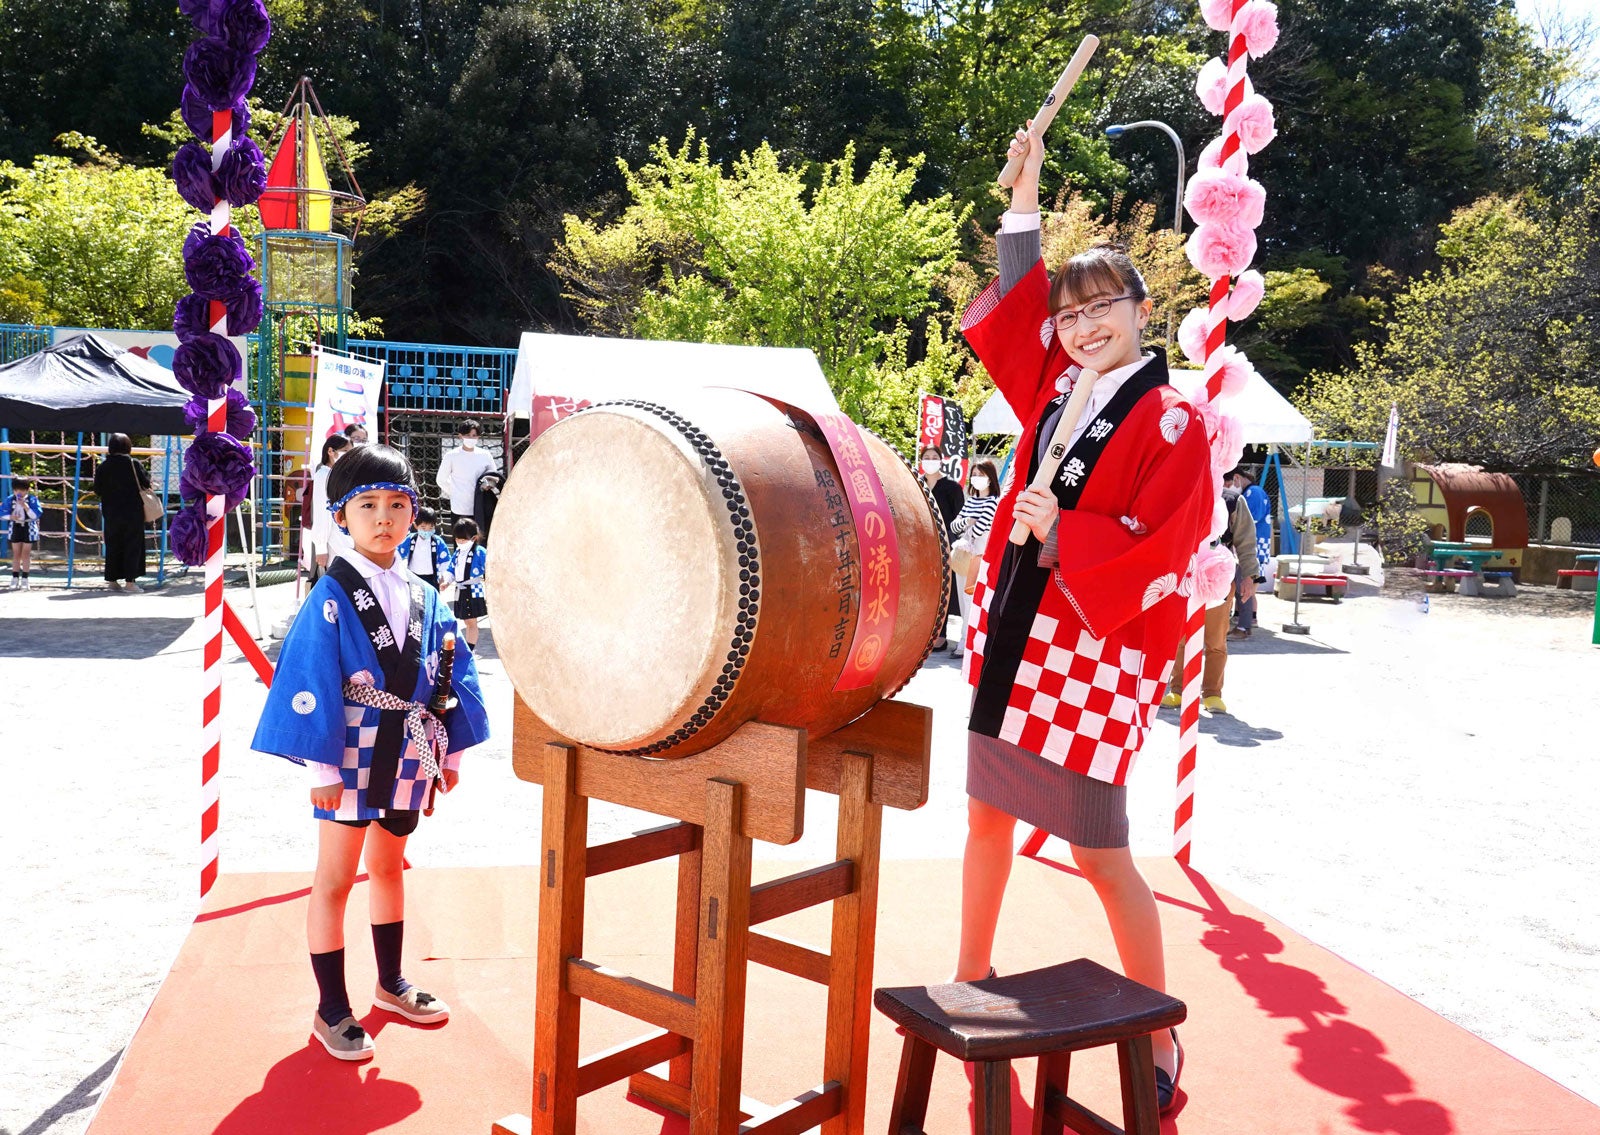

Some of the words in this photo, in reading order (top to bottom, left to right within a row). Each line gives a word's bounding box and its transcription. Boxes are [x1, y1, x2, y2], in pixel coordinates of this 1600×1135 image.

[1060, 418, 1114, 487] 御祭
[814, 469, 856, 659] 昭和五十年三月吉日
[823, 413, 892, 626] 幼稚園の清水
[353, 588, 395, 651] 若連
